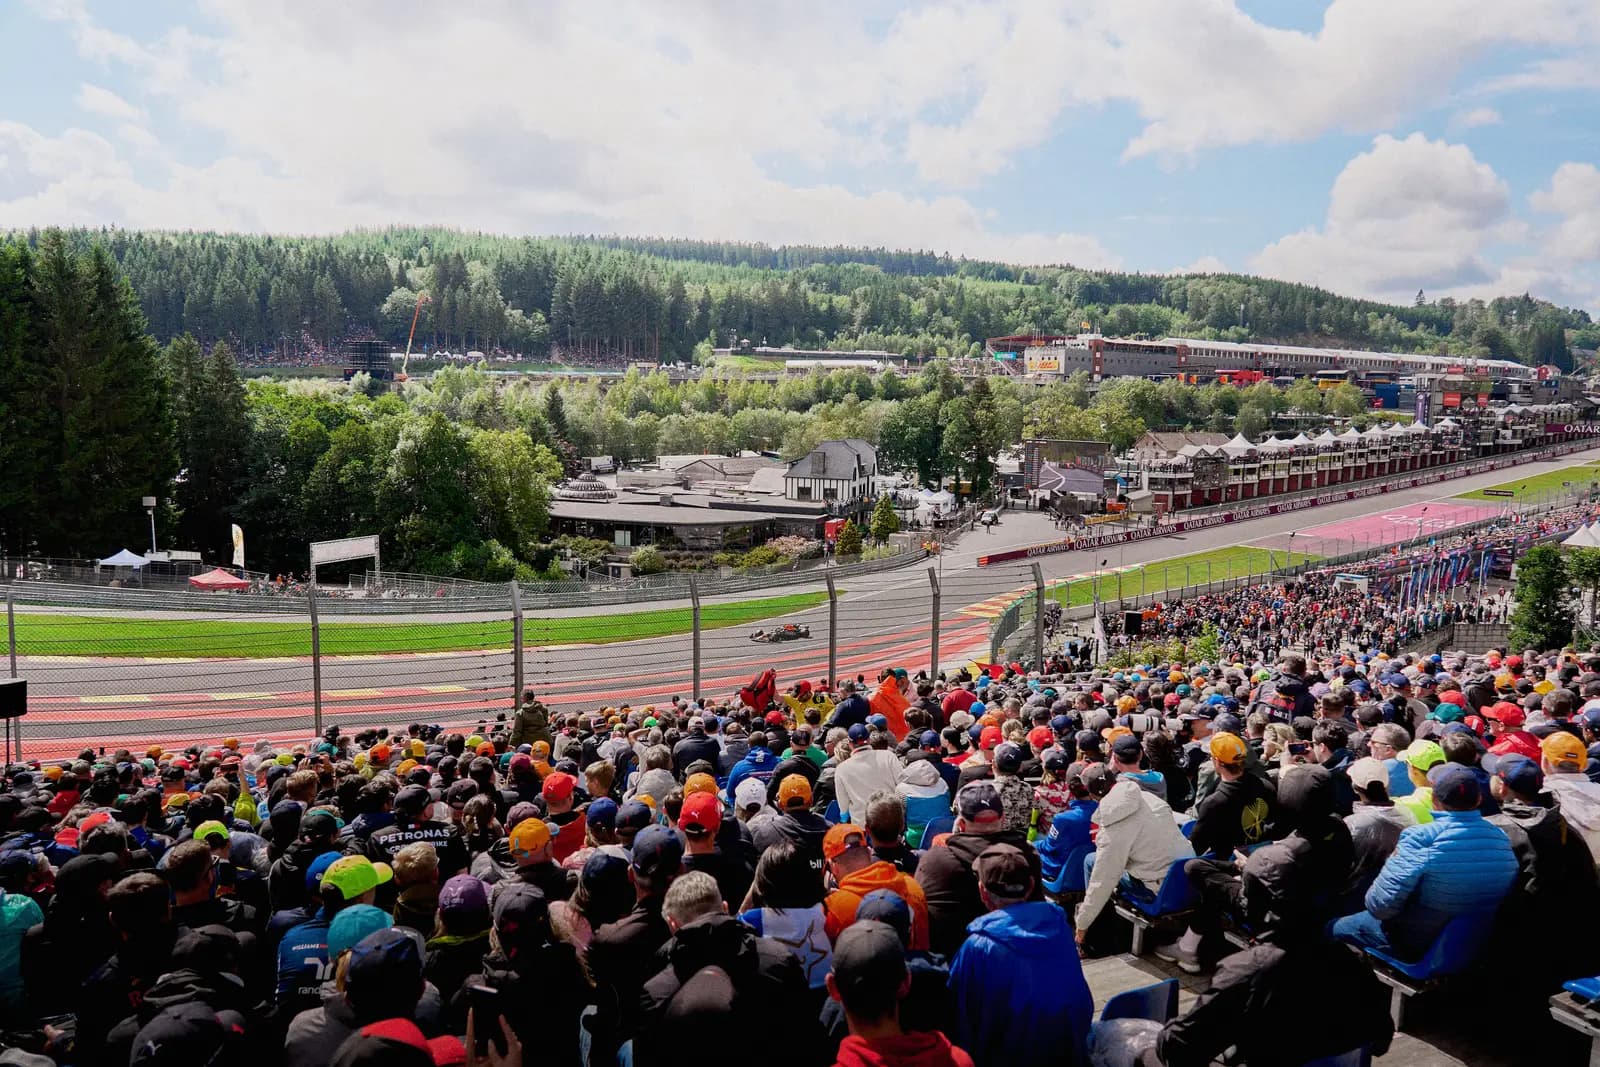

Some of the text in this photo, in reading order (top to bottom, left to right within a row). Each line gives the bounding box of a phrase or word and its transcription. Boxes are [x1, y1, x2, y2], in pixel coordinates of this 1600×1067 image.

[1564, 424, 1600, 433] QATAR
[1184, 515, 1225, 529] QATAR AIRWAYS
[1233, 510, 1250, 520] QATAR
[1131, 525, 1176, 539] QATAR AIRWAYS
[1076, 534, 1127, 549] QATAR AIRWAYS
[379, 828, 451, 845] PETRONAS
